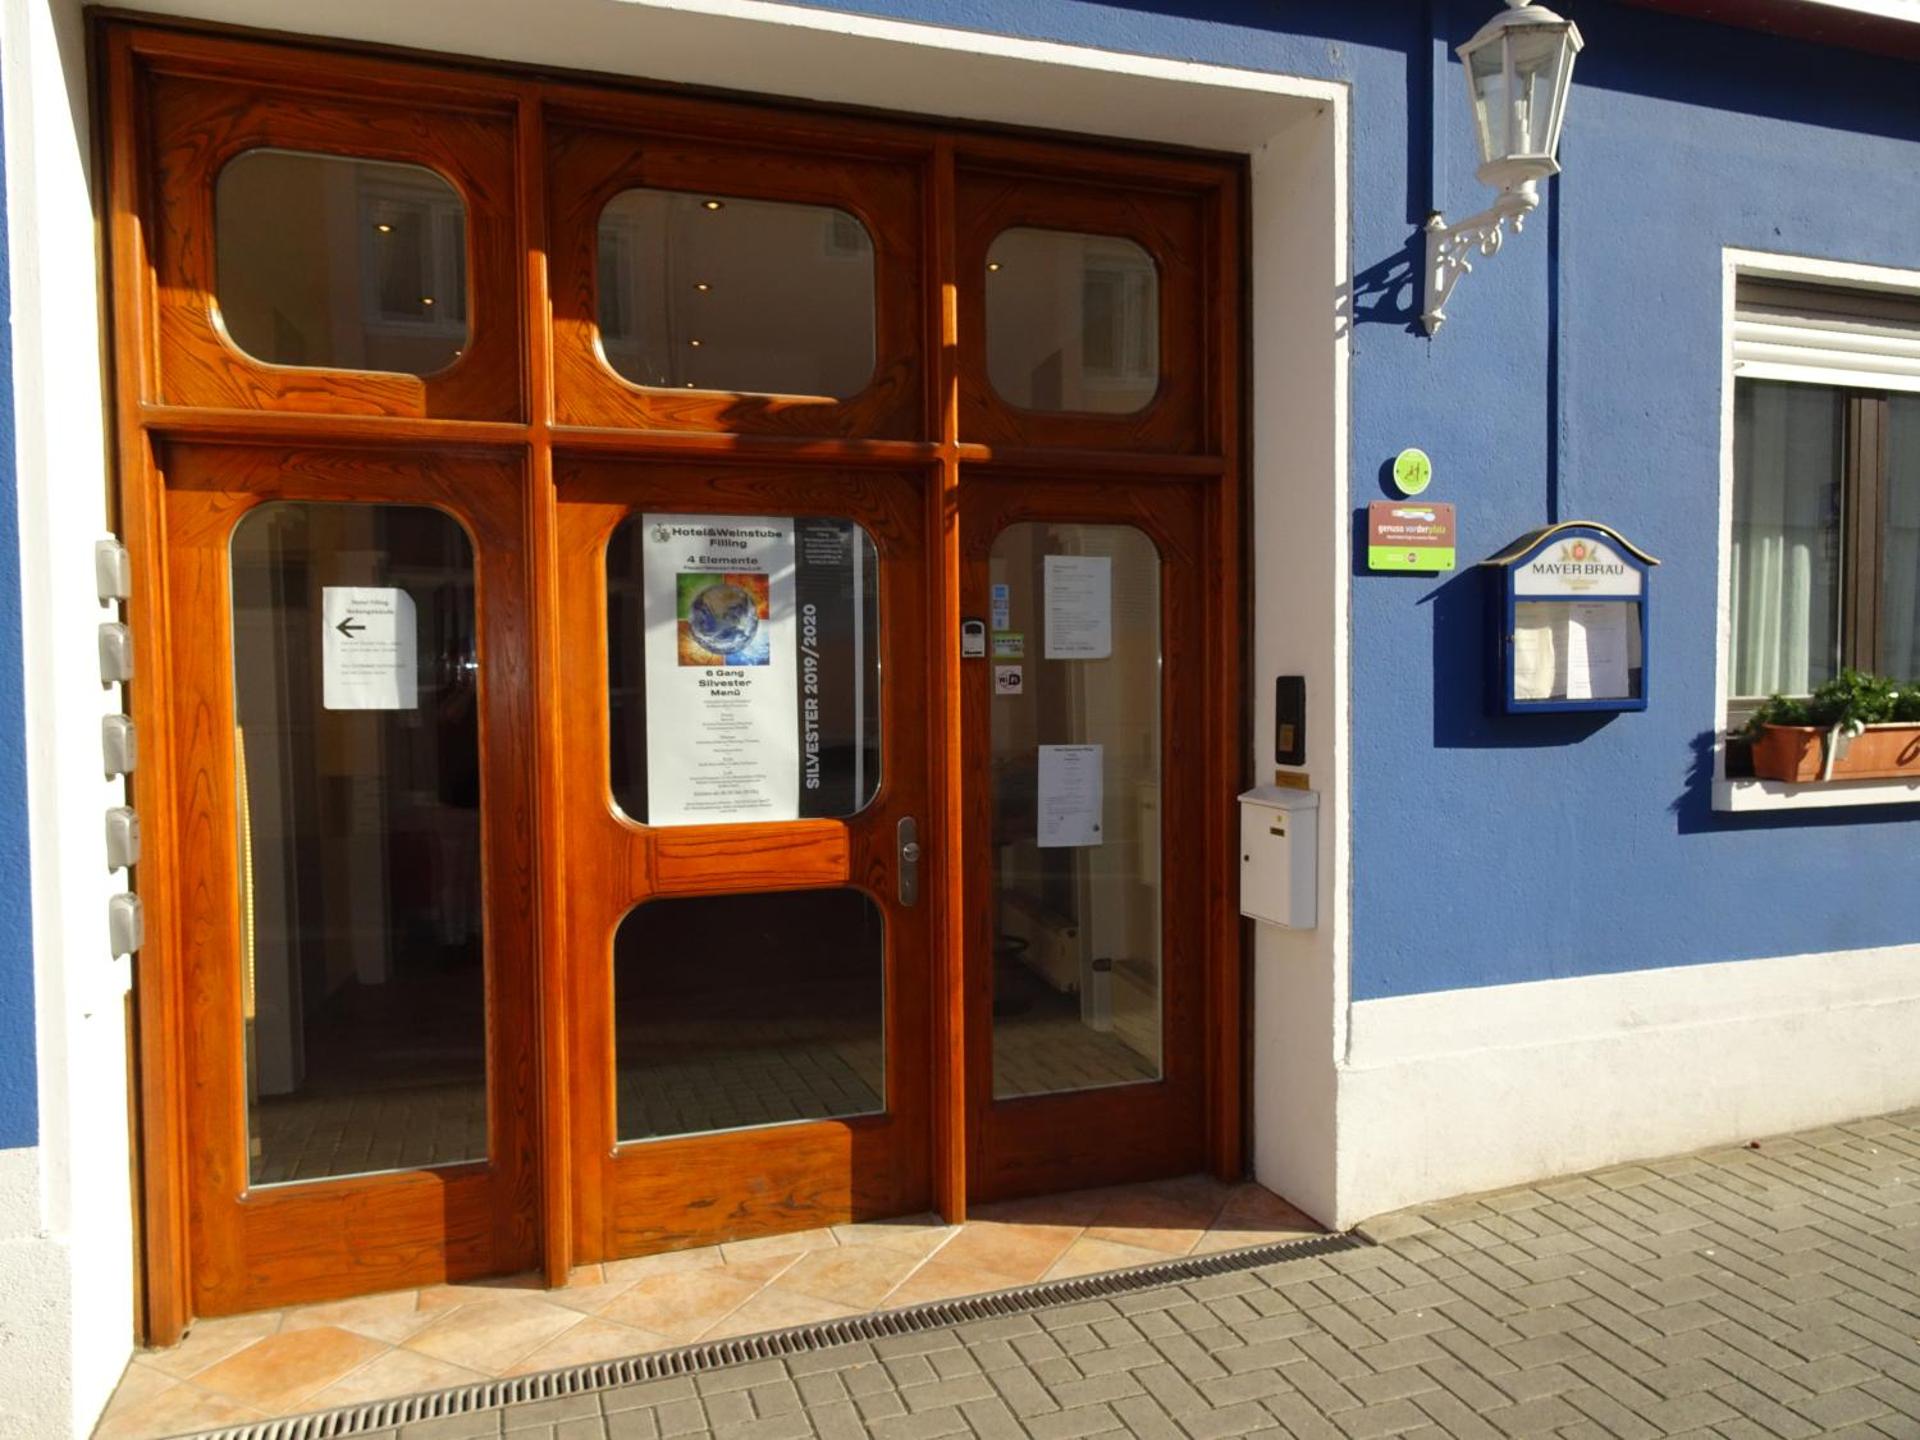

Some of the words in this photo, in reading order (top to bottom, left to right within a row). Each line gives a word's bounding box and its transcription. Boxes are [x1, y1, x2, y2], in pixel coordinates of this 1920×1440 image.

[672, 528, 782, 539] Hotel&Weinstube
[709, 539, 748, 549] Filling
[687, 556, 695, 564] 4
[699, 555, 758, 565] Elemente
[1533, 563, 1582, 575] MAYER
[801, 604, 820, 694] 2019/2020
[716, 669, 745, 679] Gang
[698, 679, 752, 688] Silvester
[711, 689, 741, 697] Menü
[804, 699, 820, 790] SILVESTER
